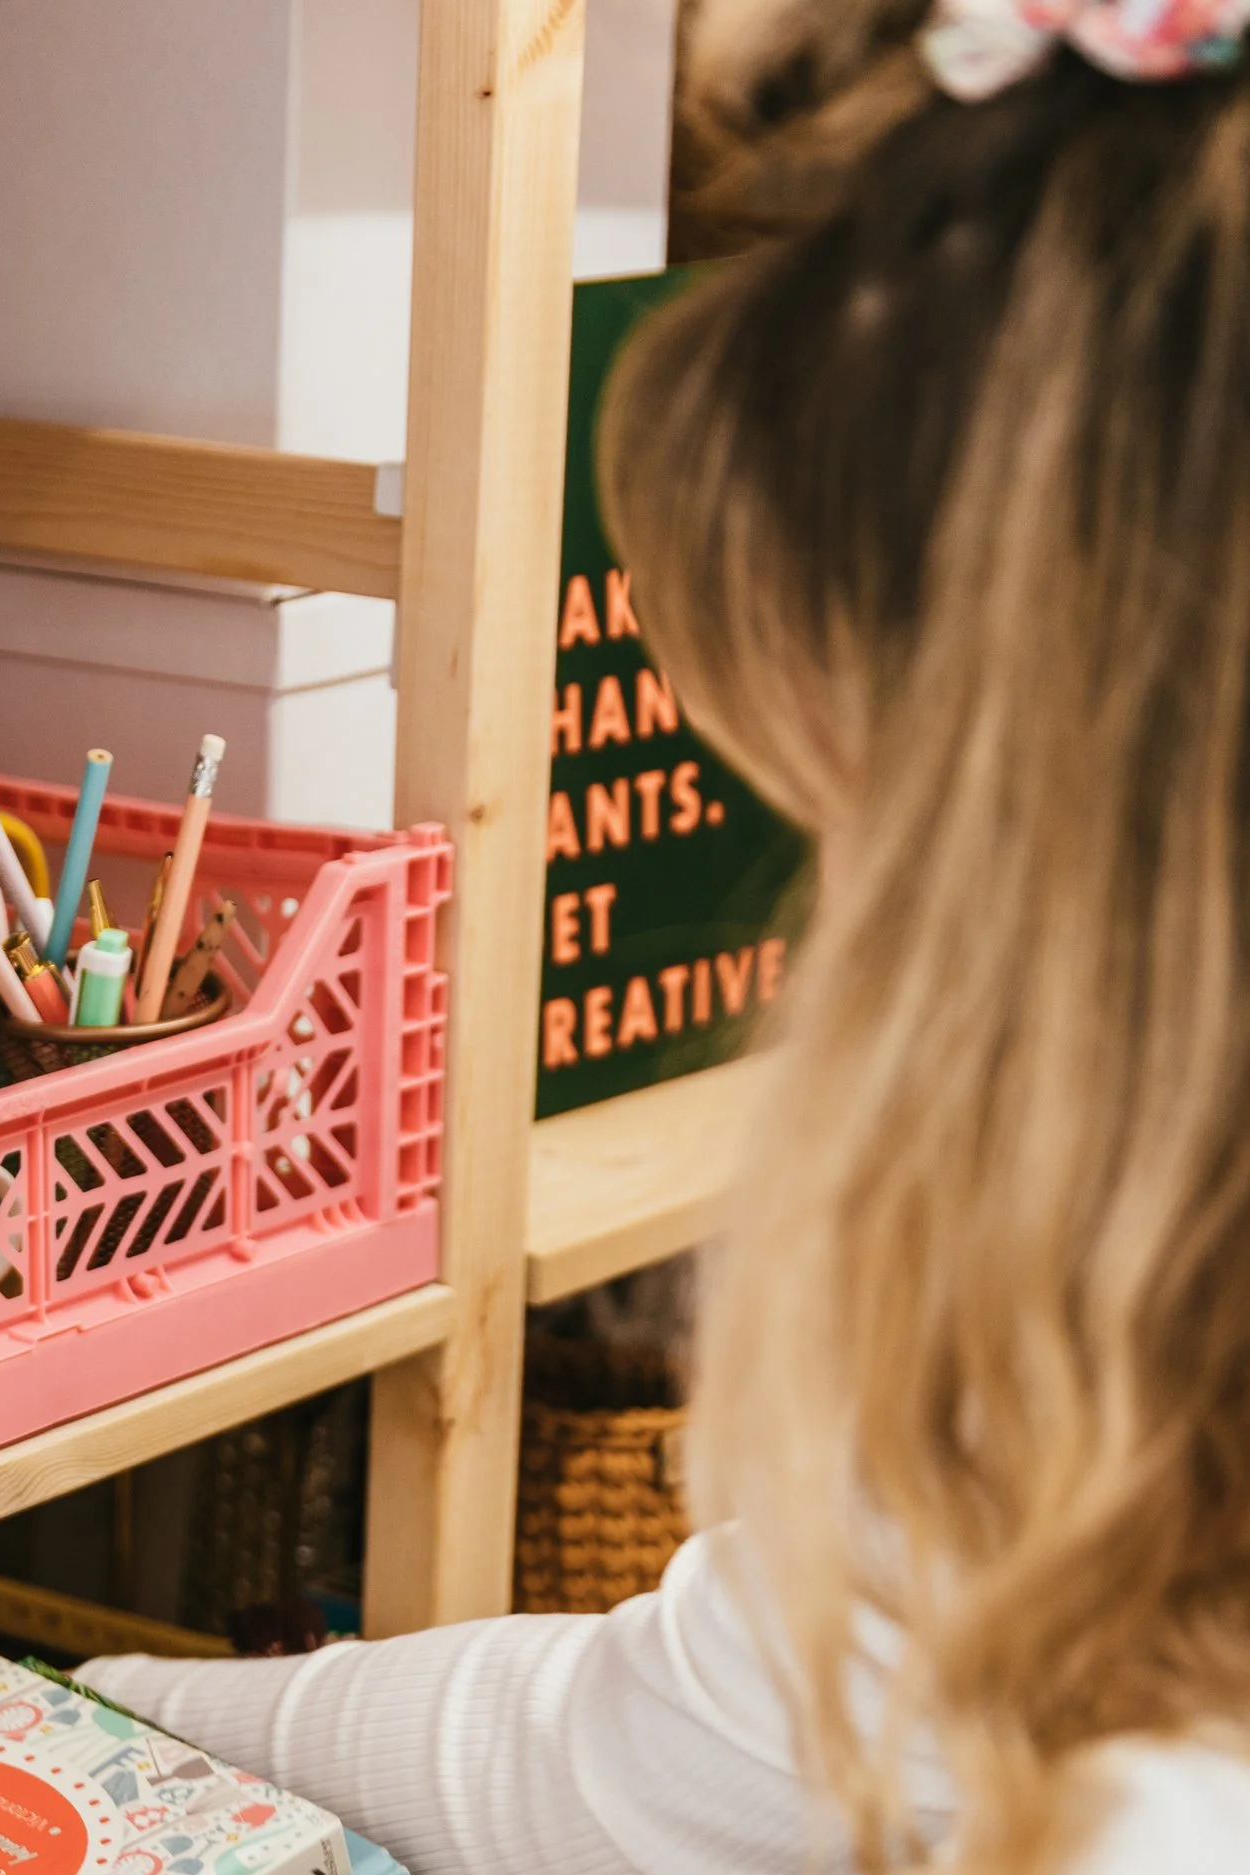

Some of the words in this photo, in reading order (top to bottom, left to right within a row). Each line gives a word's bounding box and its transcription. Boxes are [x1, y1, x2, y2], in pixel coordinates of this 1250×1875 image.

[558, 566, 640, 651] AK
[551, 667, 678, 757] HAN
[546, 759, 726, 864] ANTS.
[550, 881, 618, 967] ET
[541, 937, 788, 1072] REATIVE
